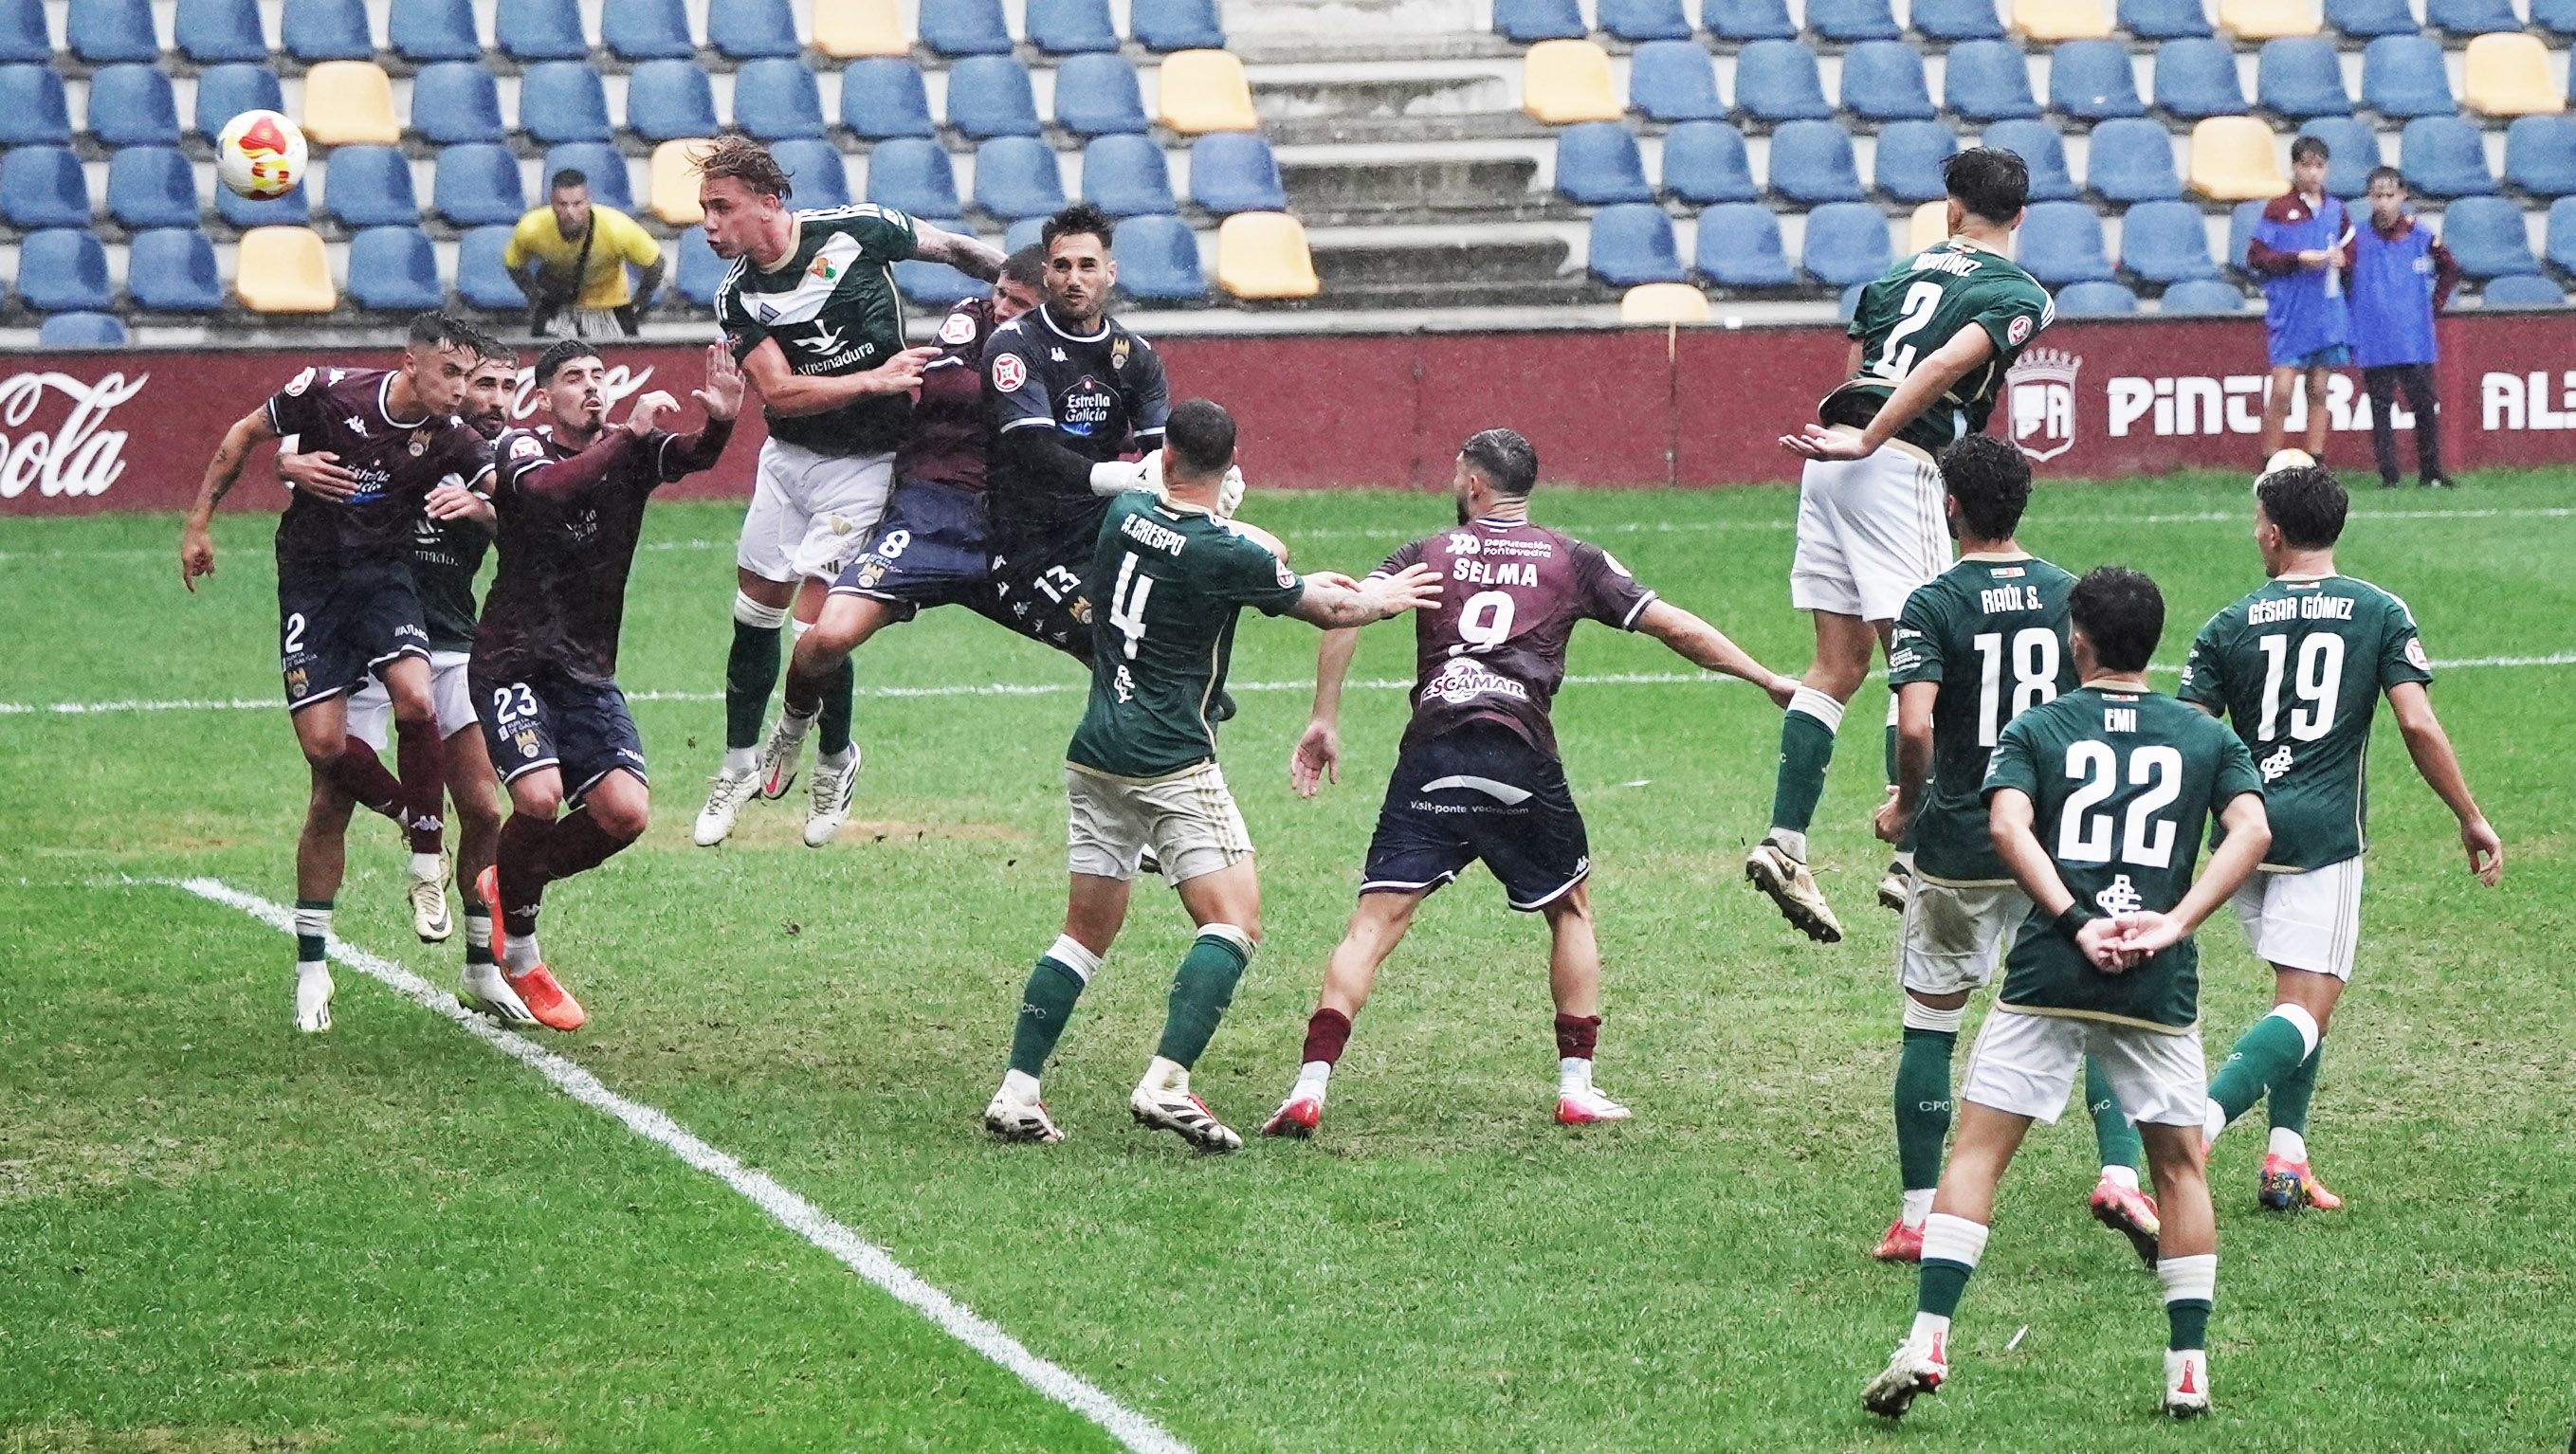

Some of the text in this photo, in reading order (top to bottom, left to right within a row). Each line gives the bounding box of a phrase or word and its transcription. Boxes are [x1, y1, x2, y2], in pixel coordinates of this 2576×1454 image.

[1873, 282, 1944, 382] 2
[793, 341, 875, 376] xtremadura
[1067, 393, 1110, 409] Estrella
[0, 372, 150, 499] ola
[878, 529, 911, 559] 8
[1033, 565, 1082, 605] 13
[1452, 557, 1539, 588] SELMA
[1109, 551, 1155, 661] 4
[1981, 584, 2043, 614] RAÚL S.
[2249, 591, 2355, 626] CÉSAR GÓMEZ
[285, 612, 305, 654] 2
[1448, 591, 1516, 657] 9
[494, 682, 539, 725] 23
[1422, 674, 1527, 701] ESCAMAR
[1973, 627, 2060, 747] 18
[2257, 631, 2345, 742] 19
[2104, 708, 2137, 733] EMI
[2057, 739, 2183, 869] 22
